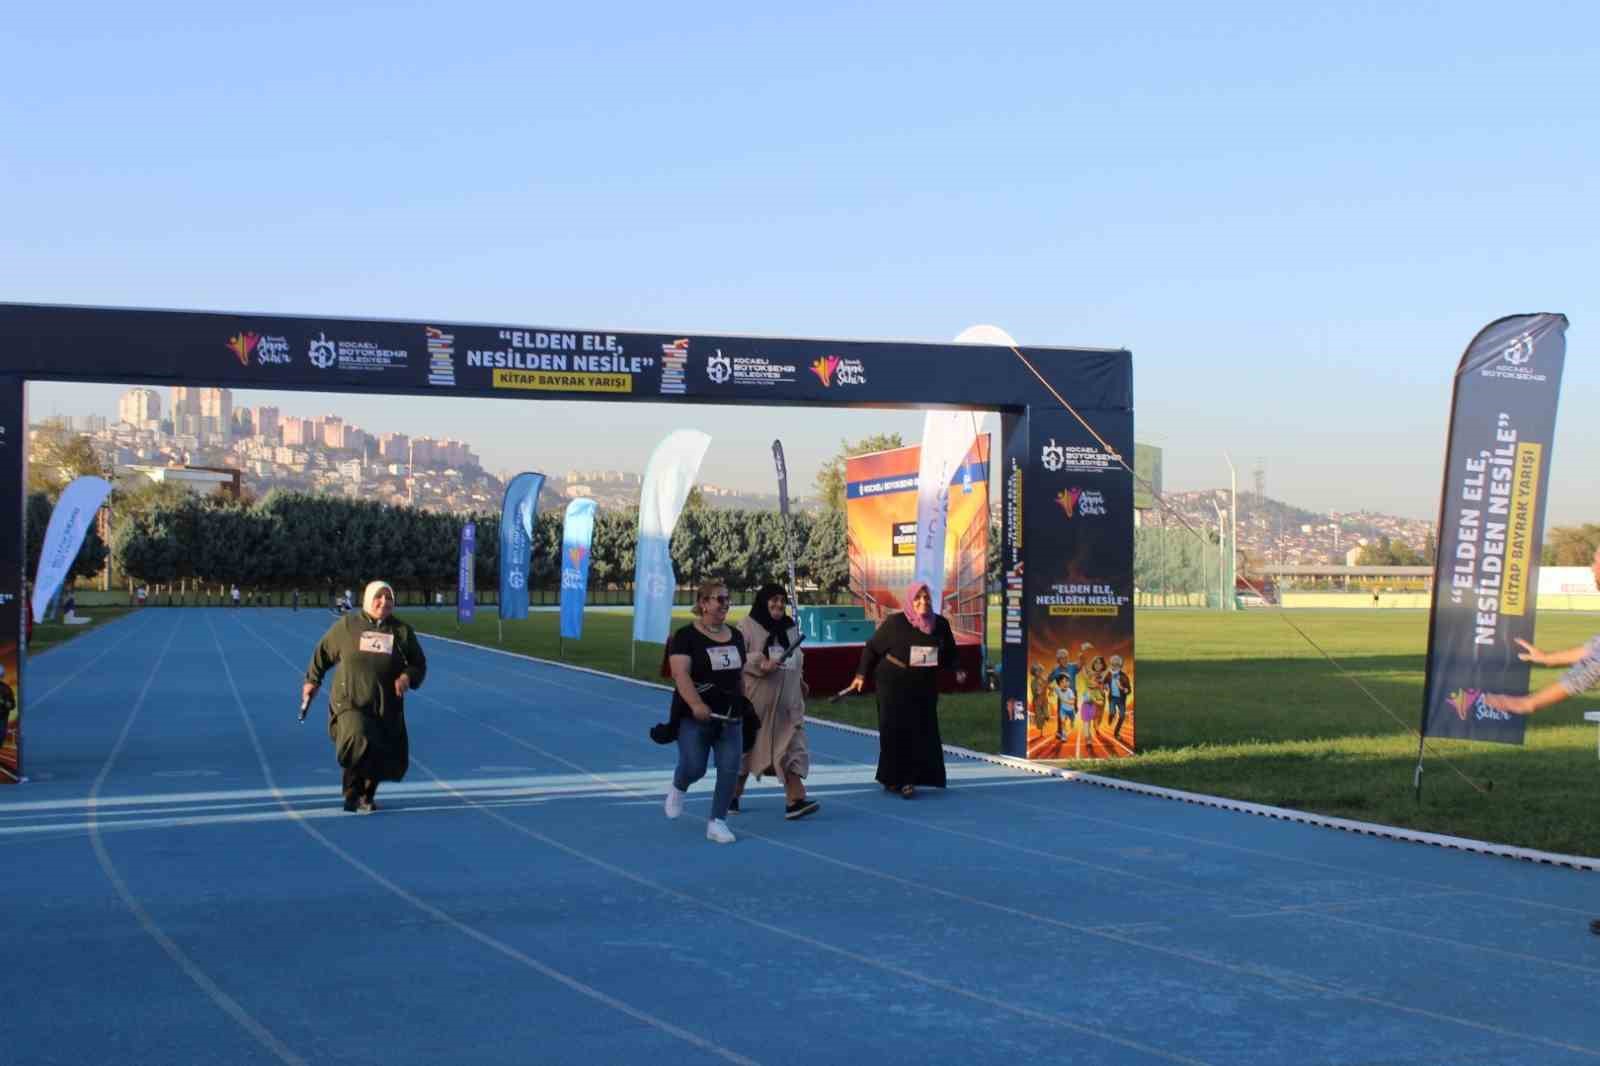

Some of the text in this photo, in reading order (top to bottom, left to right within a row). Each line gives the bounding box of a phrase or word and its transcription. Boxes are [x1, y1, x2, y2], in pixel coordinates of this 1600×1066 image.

[466, 348, 567, 371] NESİLDEN
[582, 335, 624, 354] ELE,
[500, 372, 536, 385] KİTAP
[539, 375, 586, 387] BAYRAK
[1462, 450, 1491, 501] ELE,
[1510, 500, 1529, 559] BAYRAK
[1475, 522, 1507, 645] NESİLDEN
[1504, 562, 1522, 607] KİTAP
[721, 654, 731, 667] 3
